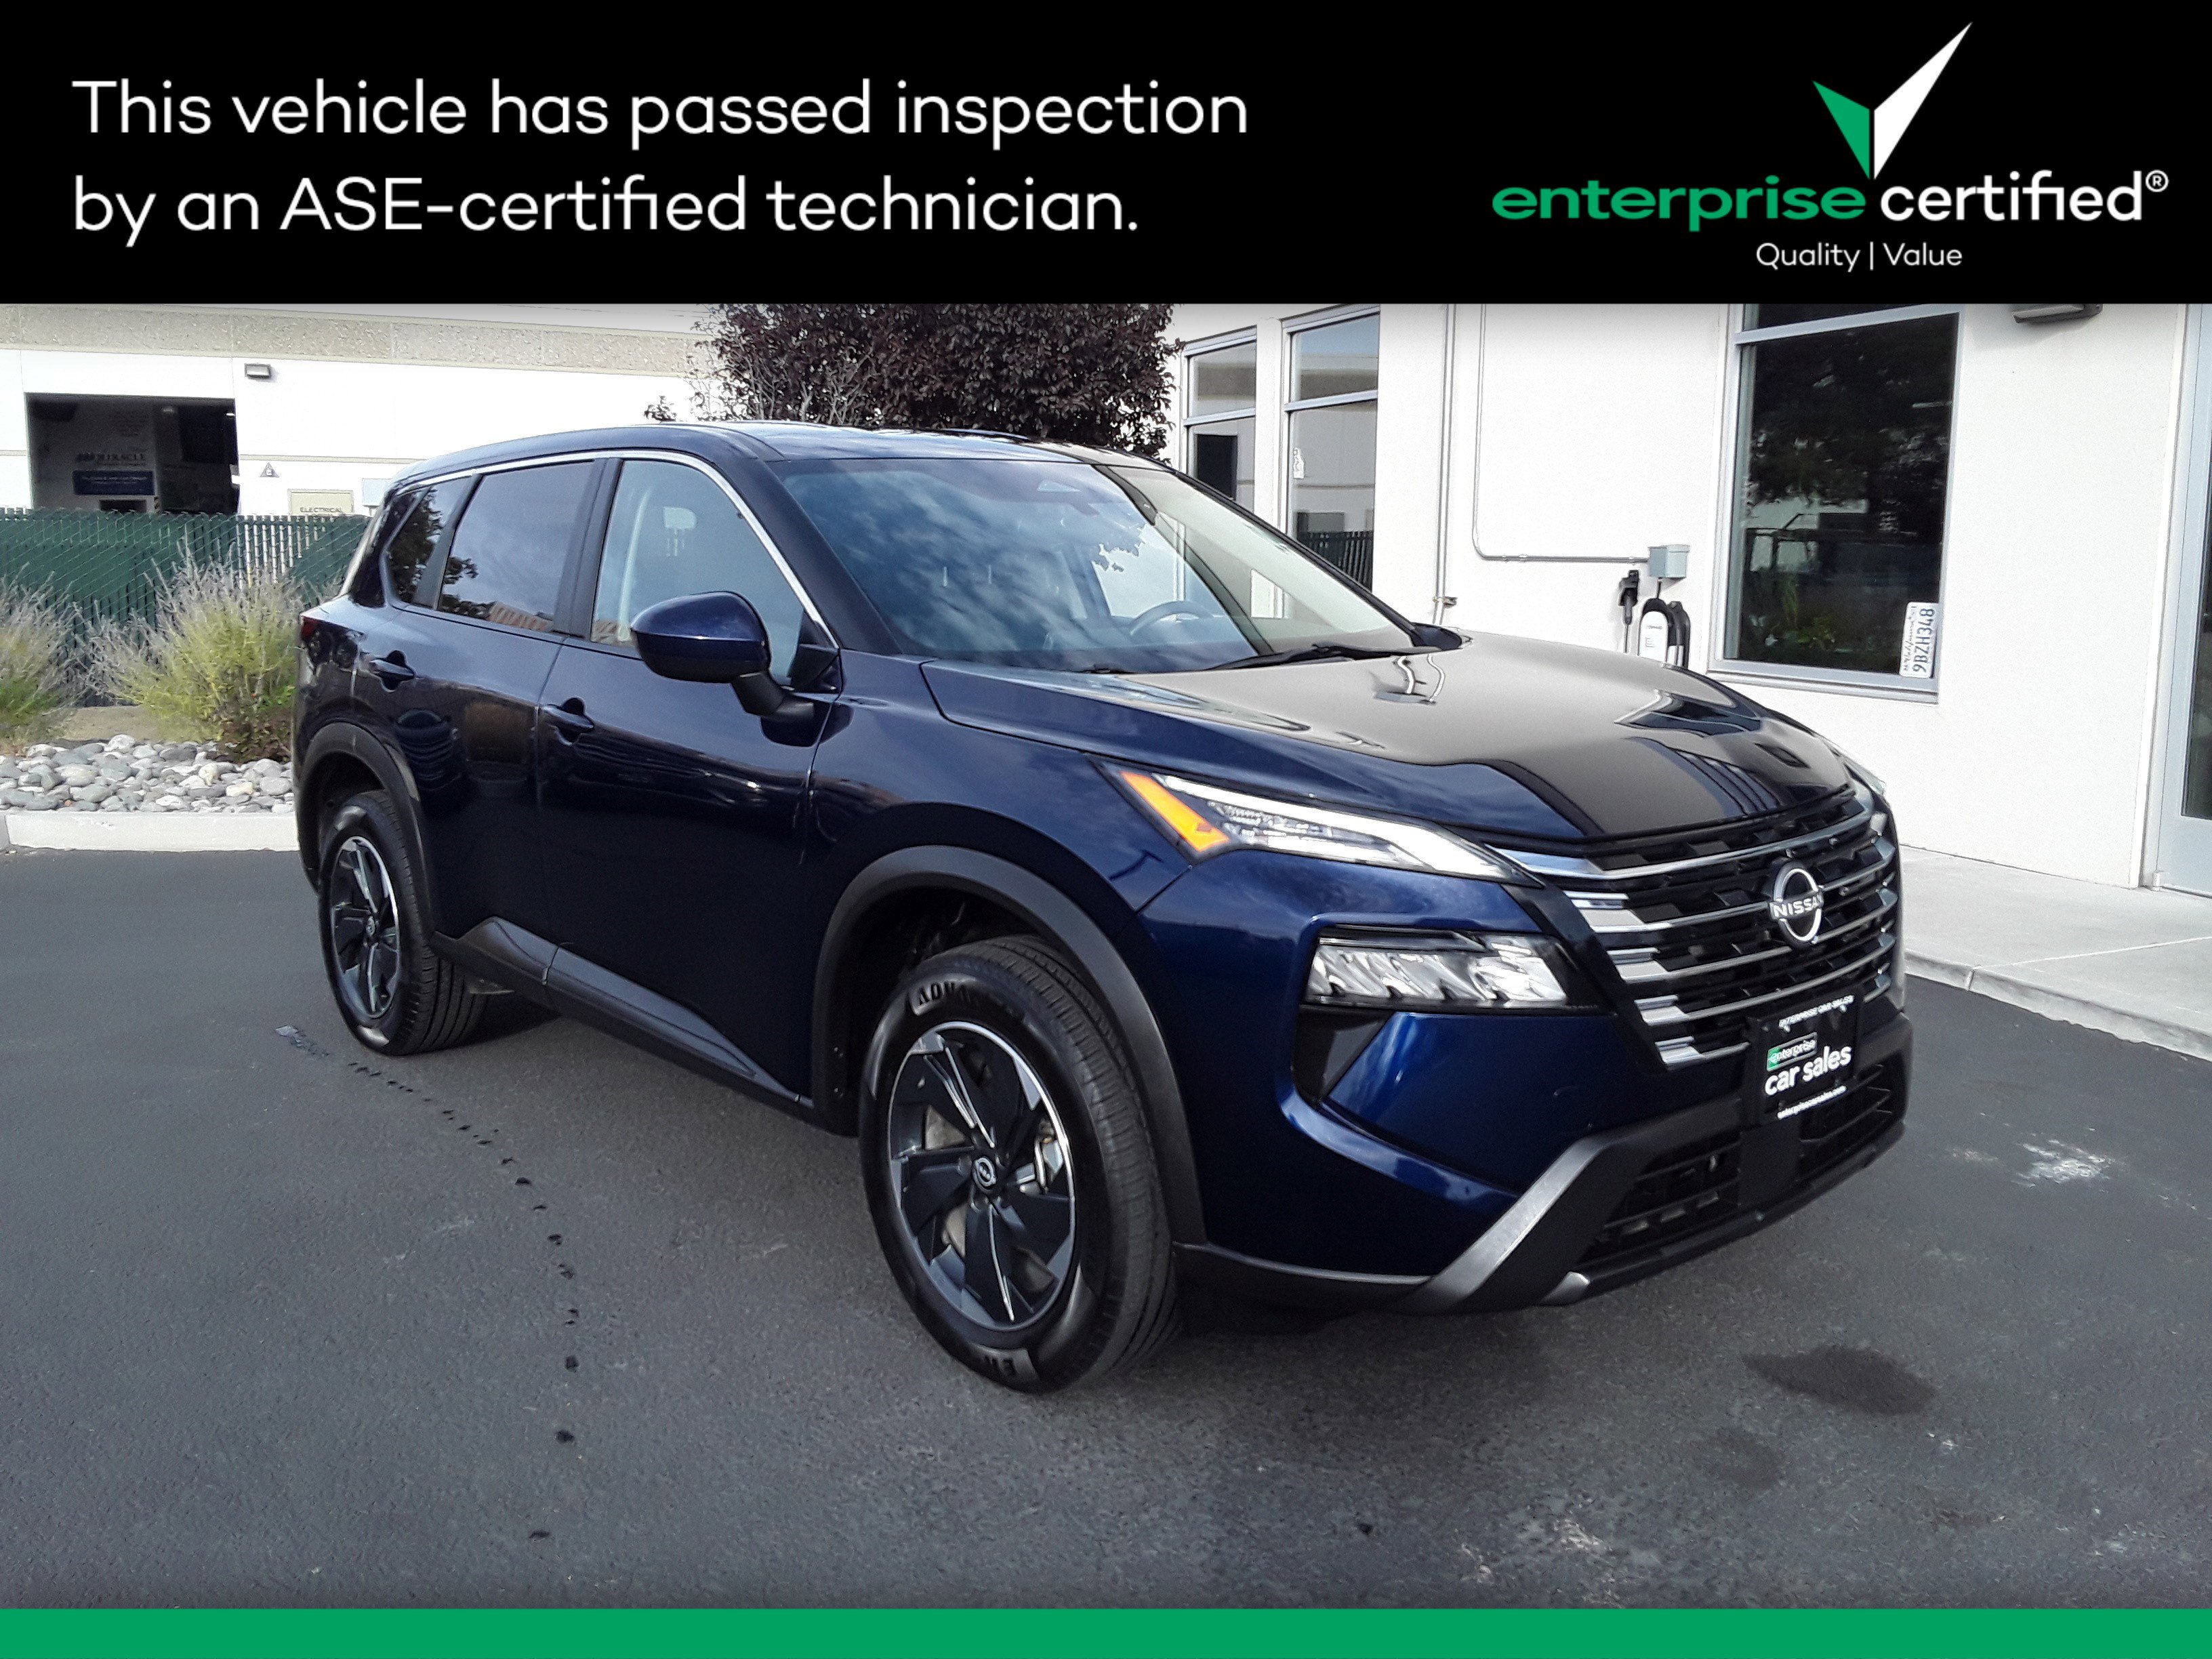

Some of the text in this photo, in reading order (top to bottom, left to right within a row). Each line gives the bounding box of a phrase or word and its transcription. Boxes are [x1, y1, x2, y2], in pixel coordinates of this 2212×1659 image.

[1912, 609, 1936, 672] 9BZH348
[1765, 1045, 1852, 1096] car sales
[1769, 1039, 1816, 1064] enterprise
